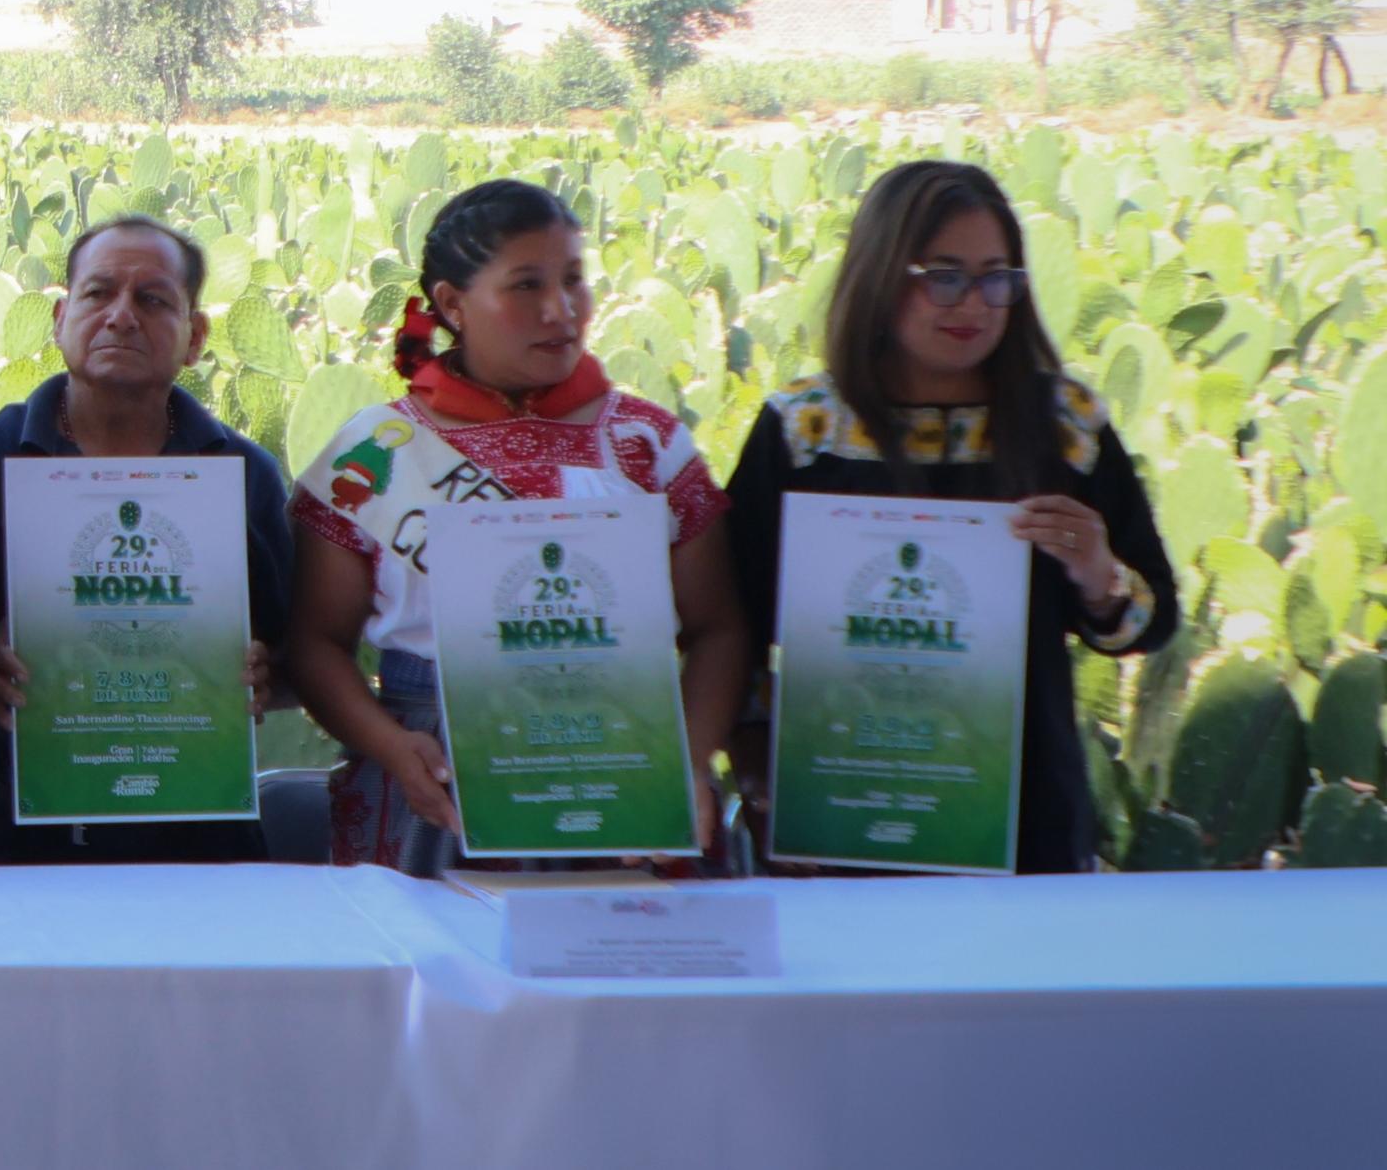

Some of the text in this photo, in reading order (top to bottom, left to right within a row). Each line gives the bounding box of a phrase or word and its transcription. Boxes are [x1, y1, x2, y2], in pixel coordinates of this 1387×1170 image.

[95, 560, 150, 573] FERIA
[72, 574, 194, 606] NOPAL
[56, 715, 74, 724] San
